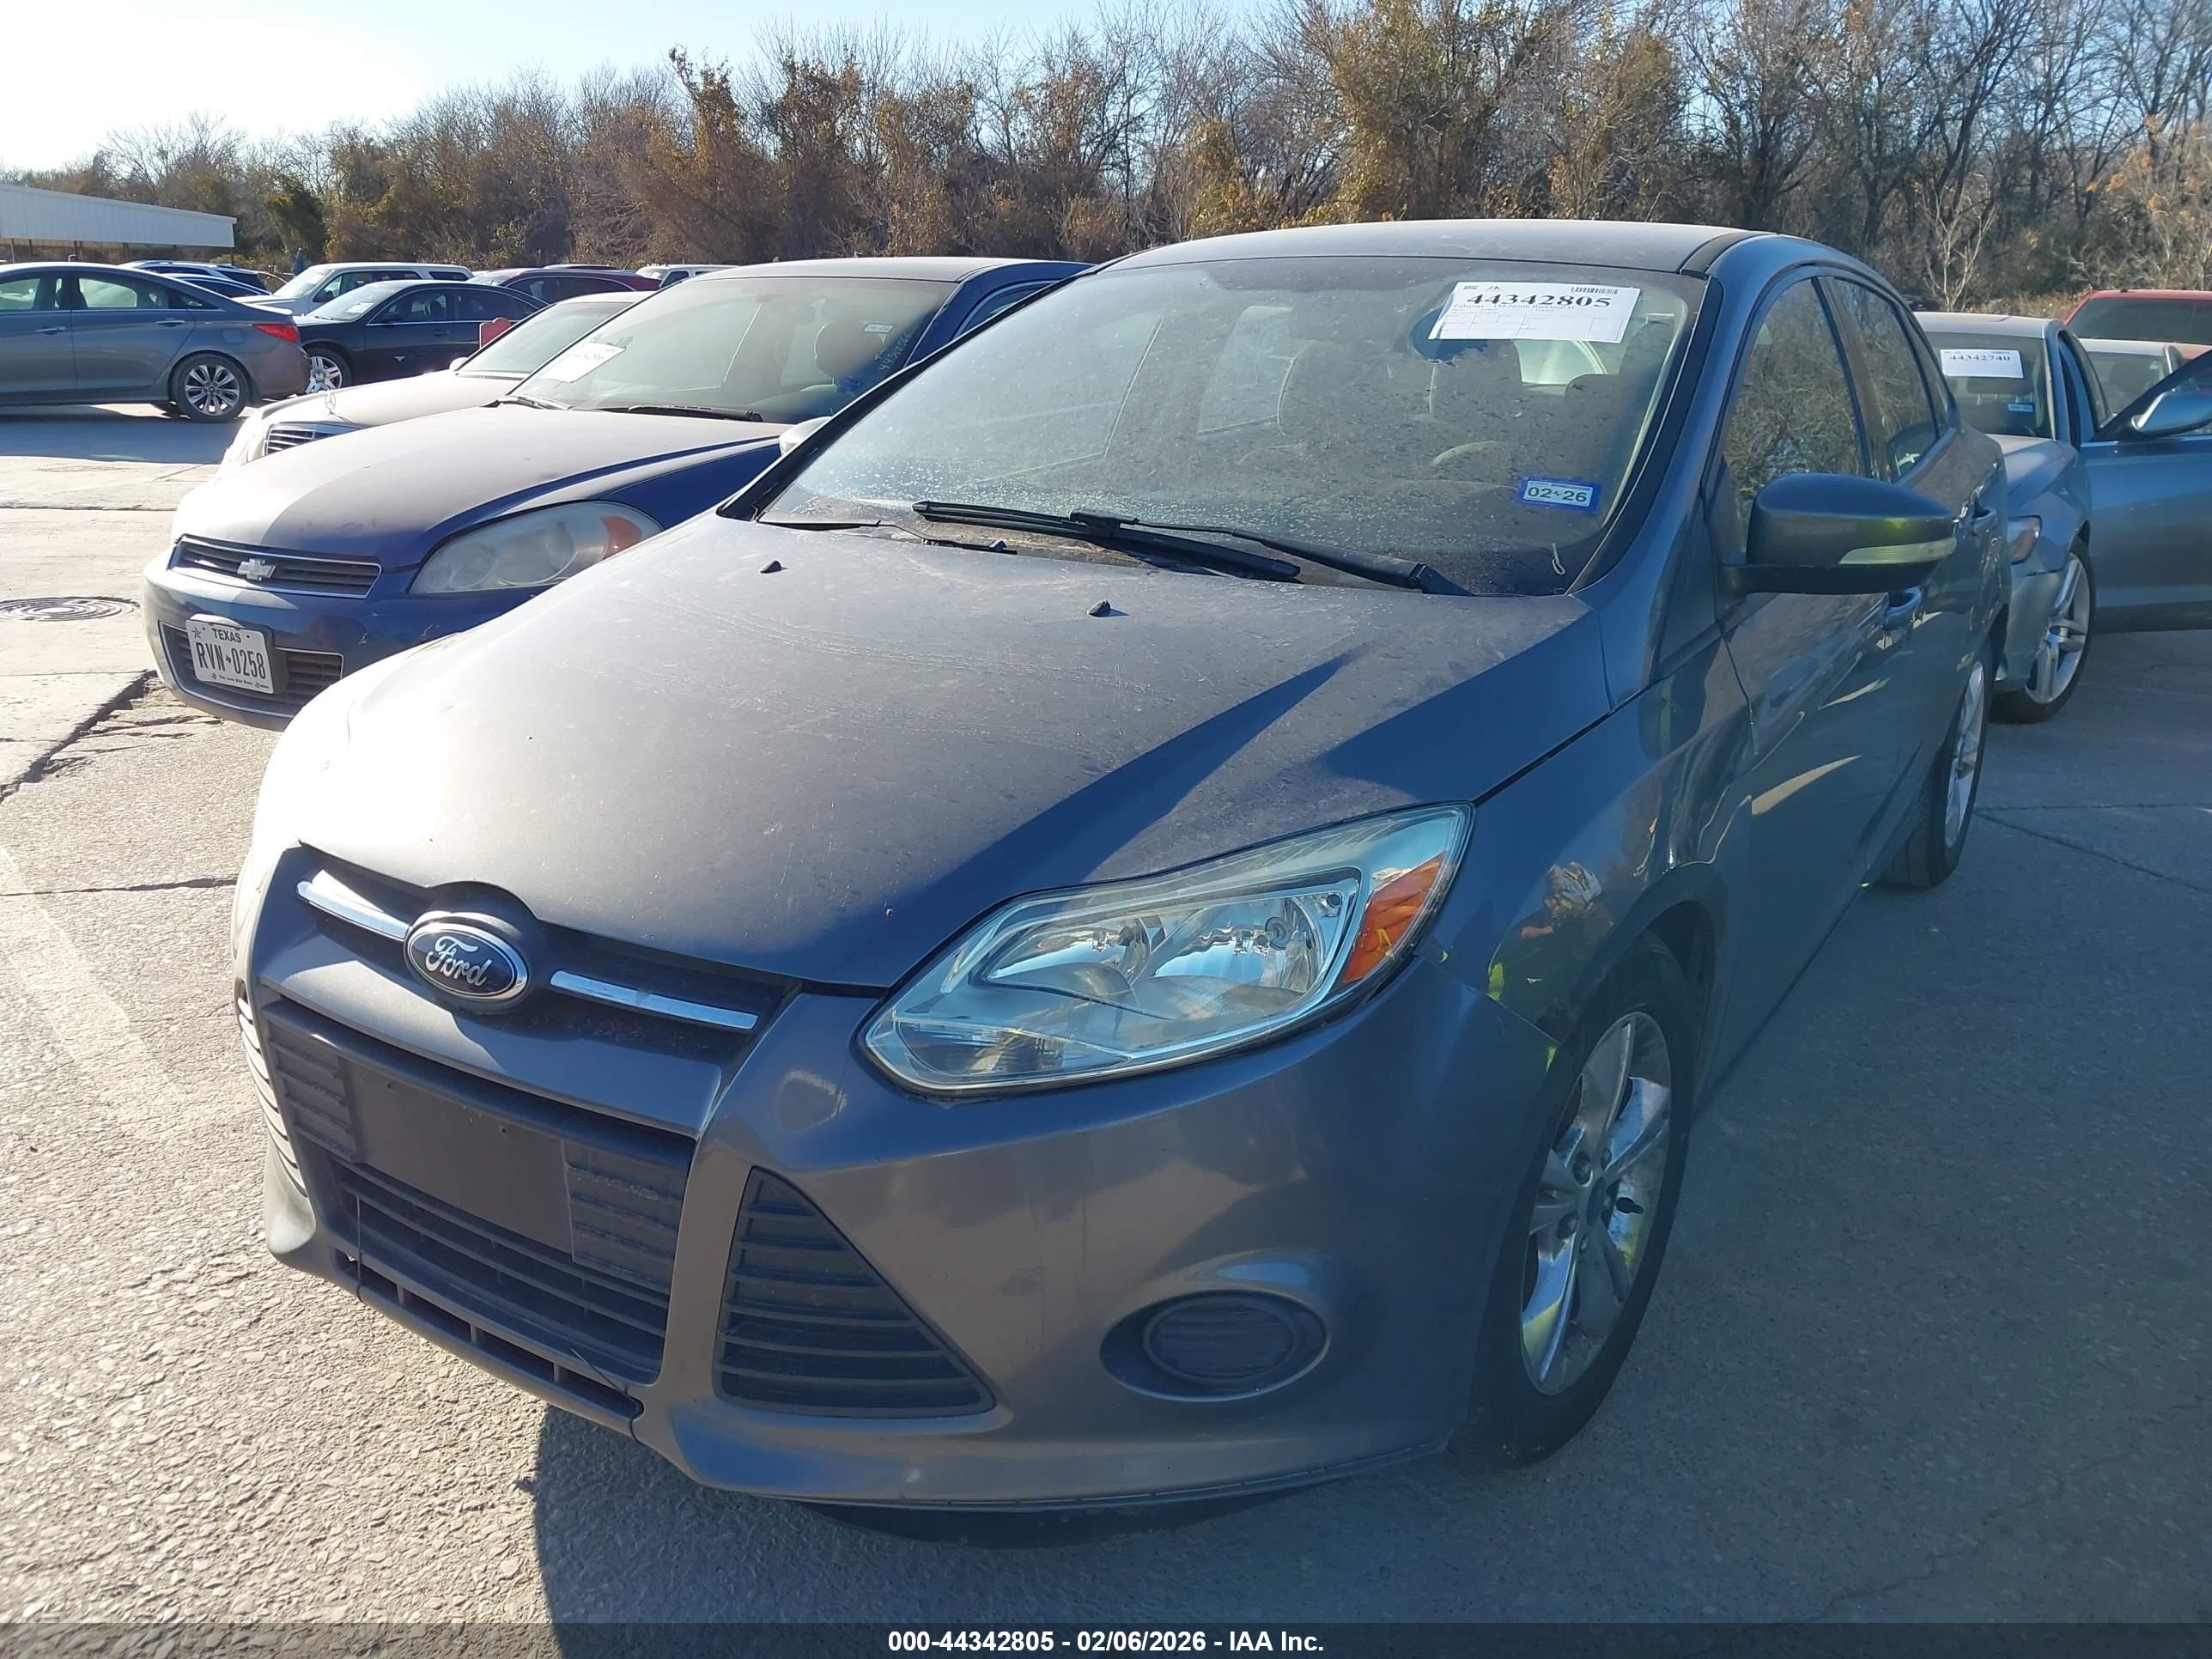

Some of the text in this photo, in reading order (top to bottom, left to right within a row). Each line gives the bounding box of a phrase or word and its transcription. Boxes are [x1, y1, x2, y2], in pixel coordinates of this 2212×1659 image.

[1467, 294, 1612, 308] 44342805
[211, 628, 242, 643] TEXAS
[425, 935, 493, 987] Ford
